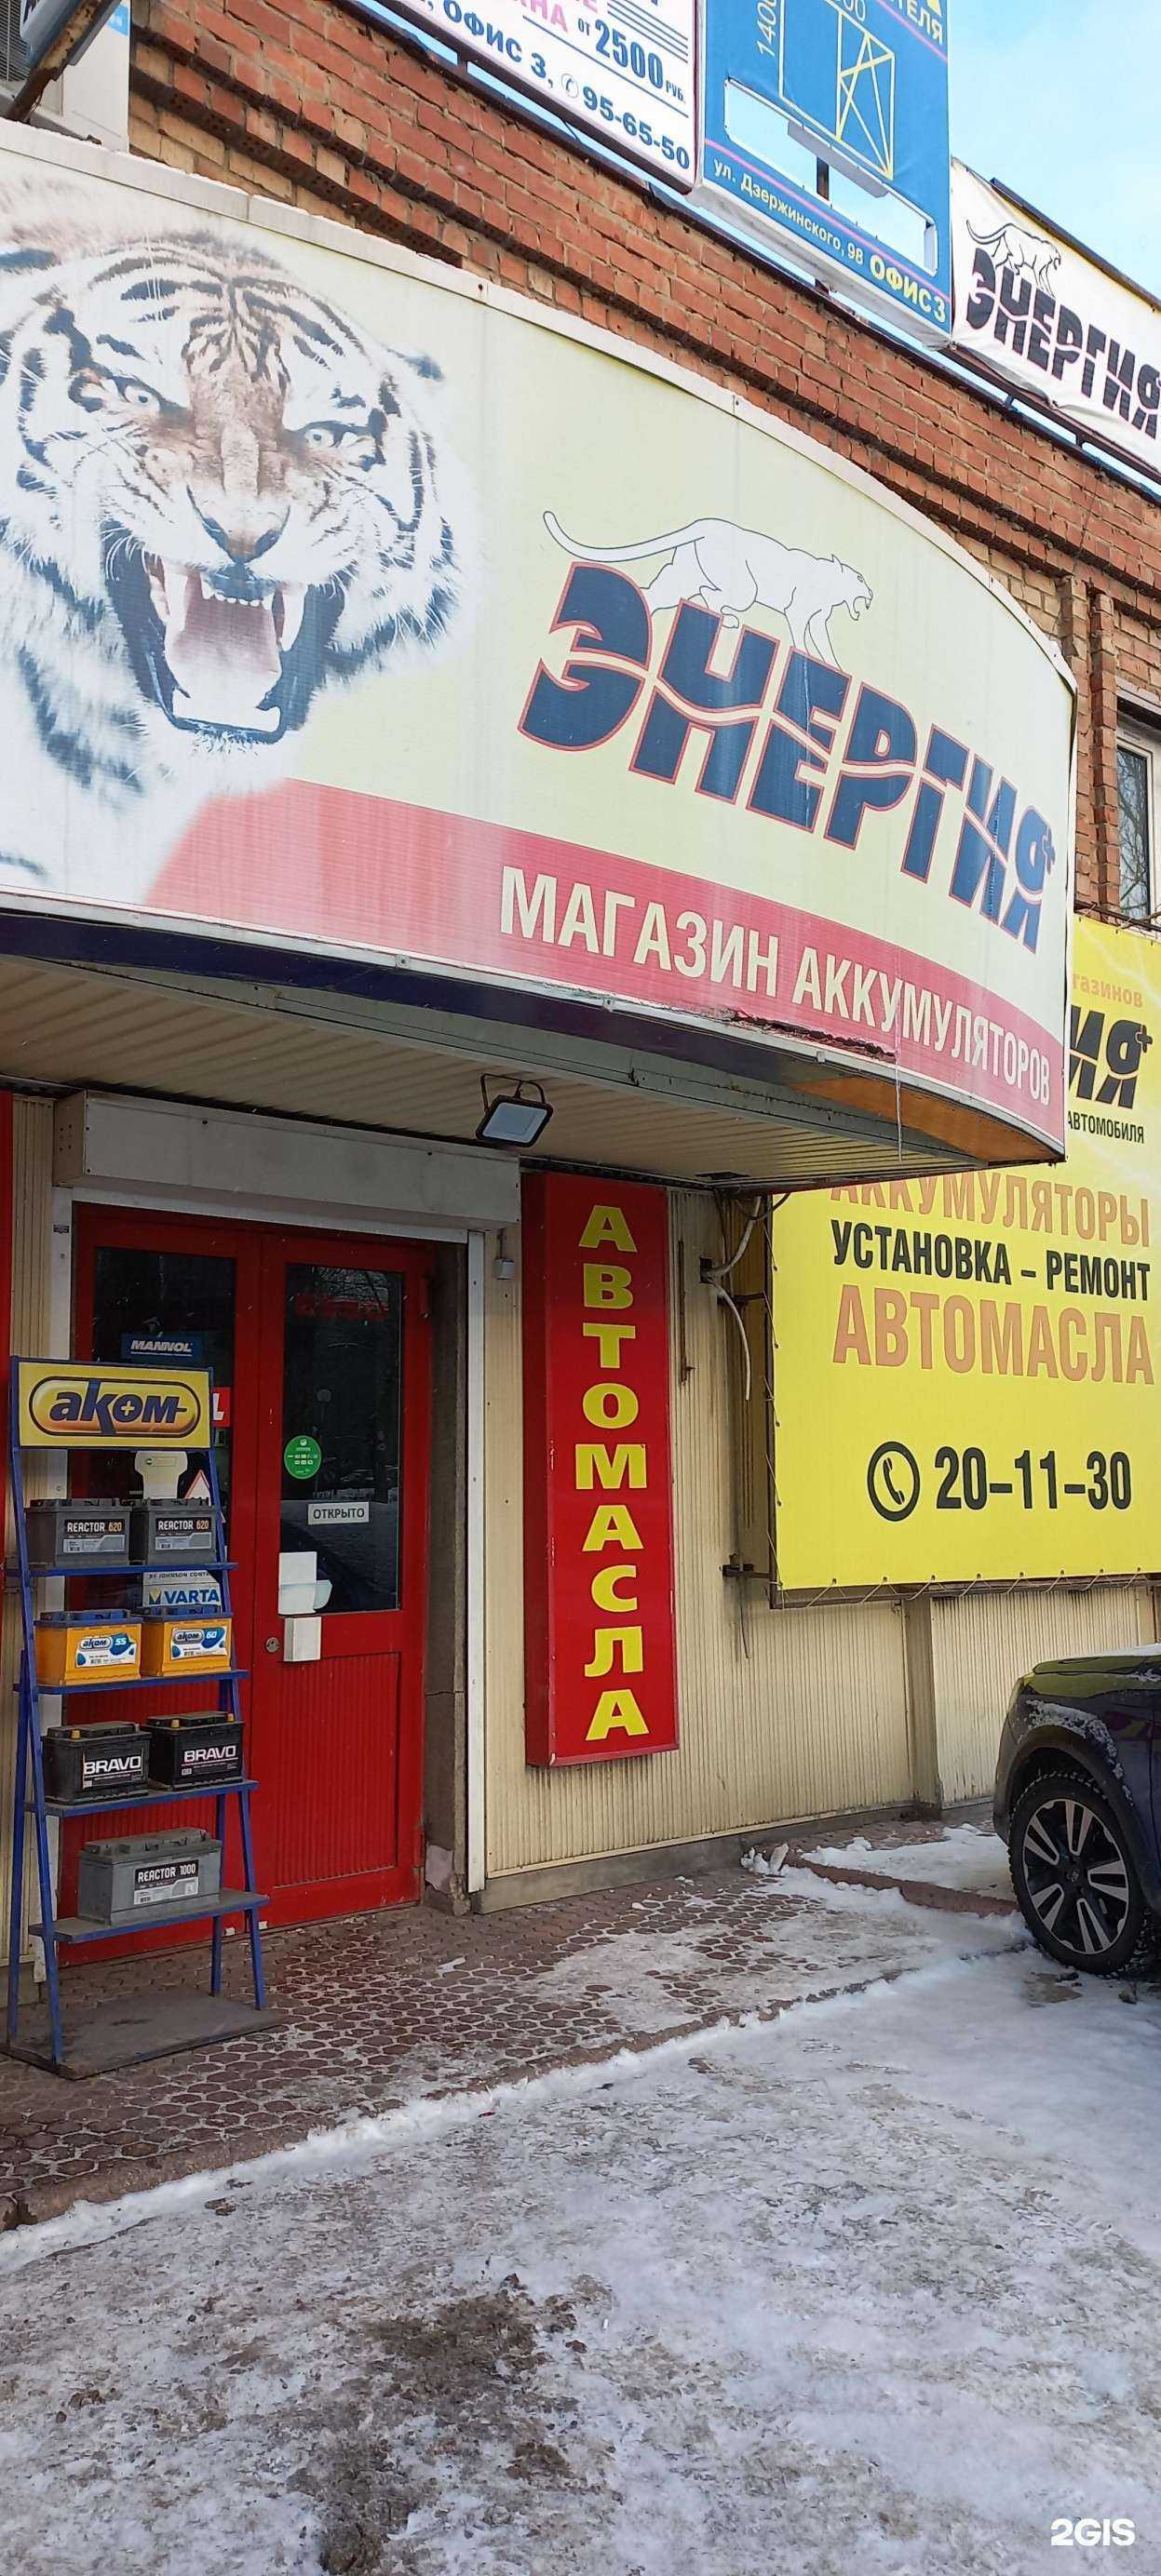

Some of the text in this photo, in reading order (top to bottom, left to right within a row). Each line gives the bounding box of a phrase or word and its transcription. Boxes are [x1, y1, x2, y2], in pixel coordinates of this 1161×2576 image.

[595, 19, 664, 89] 2500
[443, 0, 522, 63] ОФИС
[583, 86, 690, 170] 95-65-50
[713, 159, 946, 324] ул. Дзержинского, 98 ОФИС 3
[499, 865, 1051, 1107] МАГАЗИН АККУМУЛЯТОРОВ
[1072, 973, 1144, 1009] газинов
[830, 1219, 1012, 1285] УСТАНОВКА
[1046, 1250, 1151, 1301] РЕМОНТ
[832, 1283, 1154, 1385] АВТОМАСЛА
[131, 1340, 193, 1353] MANNOL
[574, 1204, 651, 1742] АВТОМАСЛА
[934, 1444, 1132, 1510] 20-11-30
[313, 1508, 365, 1519] ОТКРЫТО
[67, 1522, 123, 1533] REACTOR 620
[158, 1520, 209, 1531] REACTOR 620
[164, 1589, 221, 1603] VARTA
[115, 1638, 128, 1646] 55
[206, 1630, 217, 1639] 60
[184, 1745, 236, 1763] BRAVO
[83, 1755, 142, 1775] BRAVO
[138, 1863, 196, 1883] REACTOR 1000
